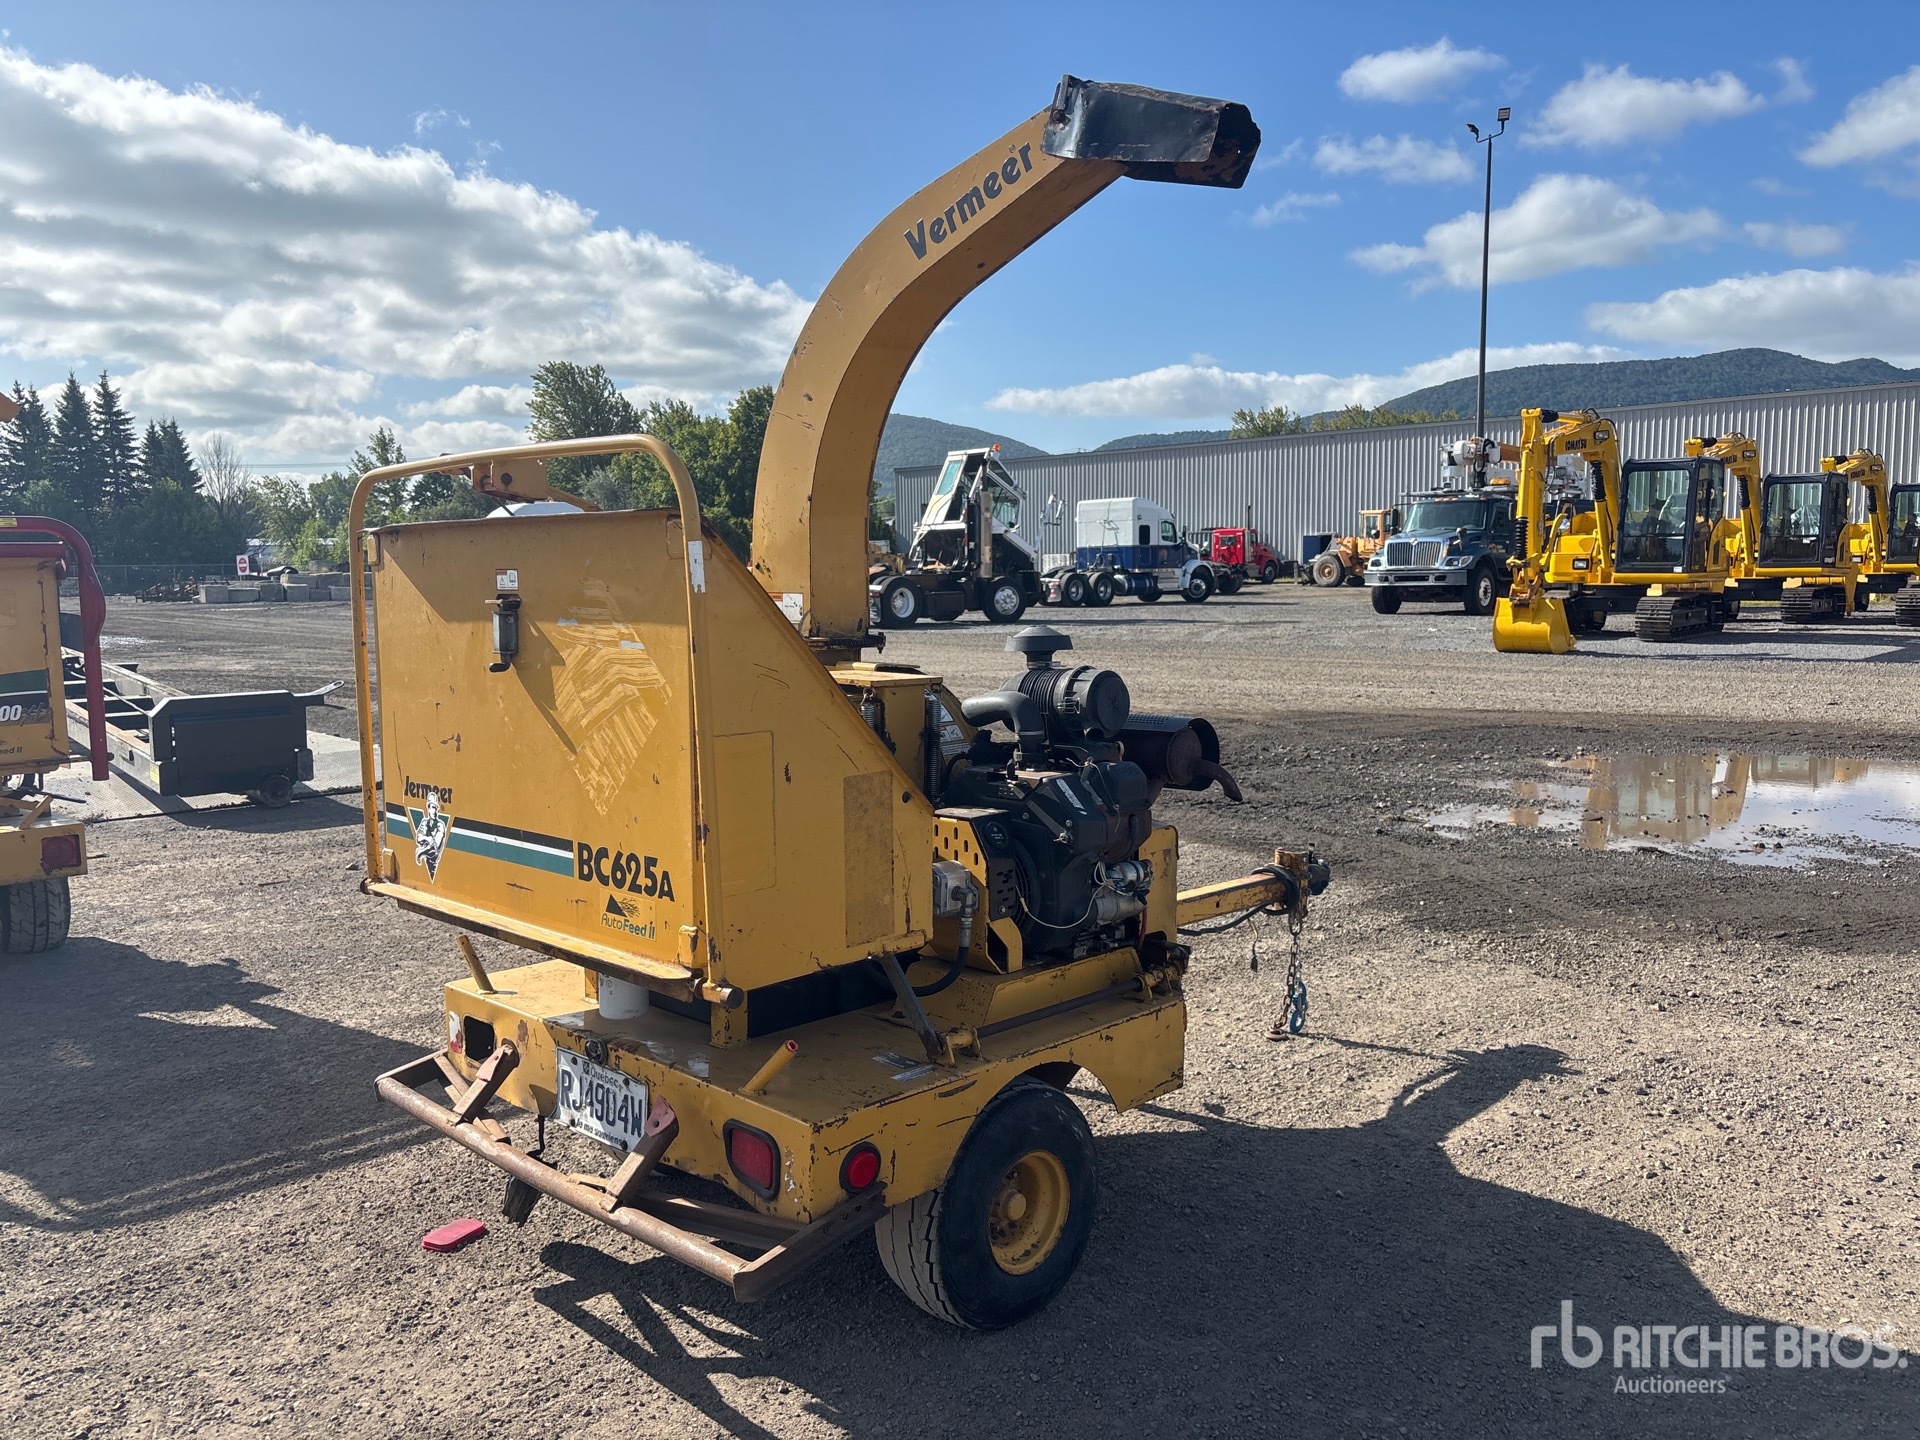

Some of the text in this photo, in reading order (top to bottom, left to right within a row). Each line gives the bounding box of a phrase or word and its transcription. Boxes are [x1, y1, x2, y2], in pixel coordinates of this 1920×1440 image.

[903, 141, 1033, 261] Vermeer
[1565, 437, 1587, 452] KOMATSU
[577, 841, 675, 903] BC625A
[601, 912, 647, 937] AutoFeed
[561, 1069, 642, 1138] RJ4904W
